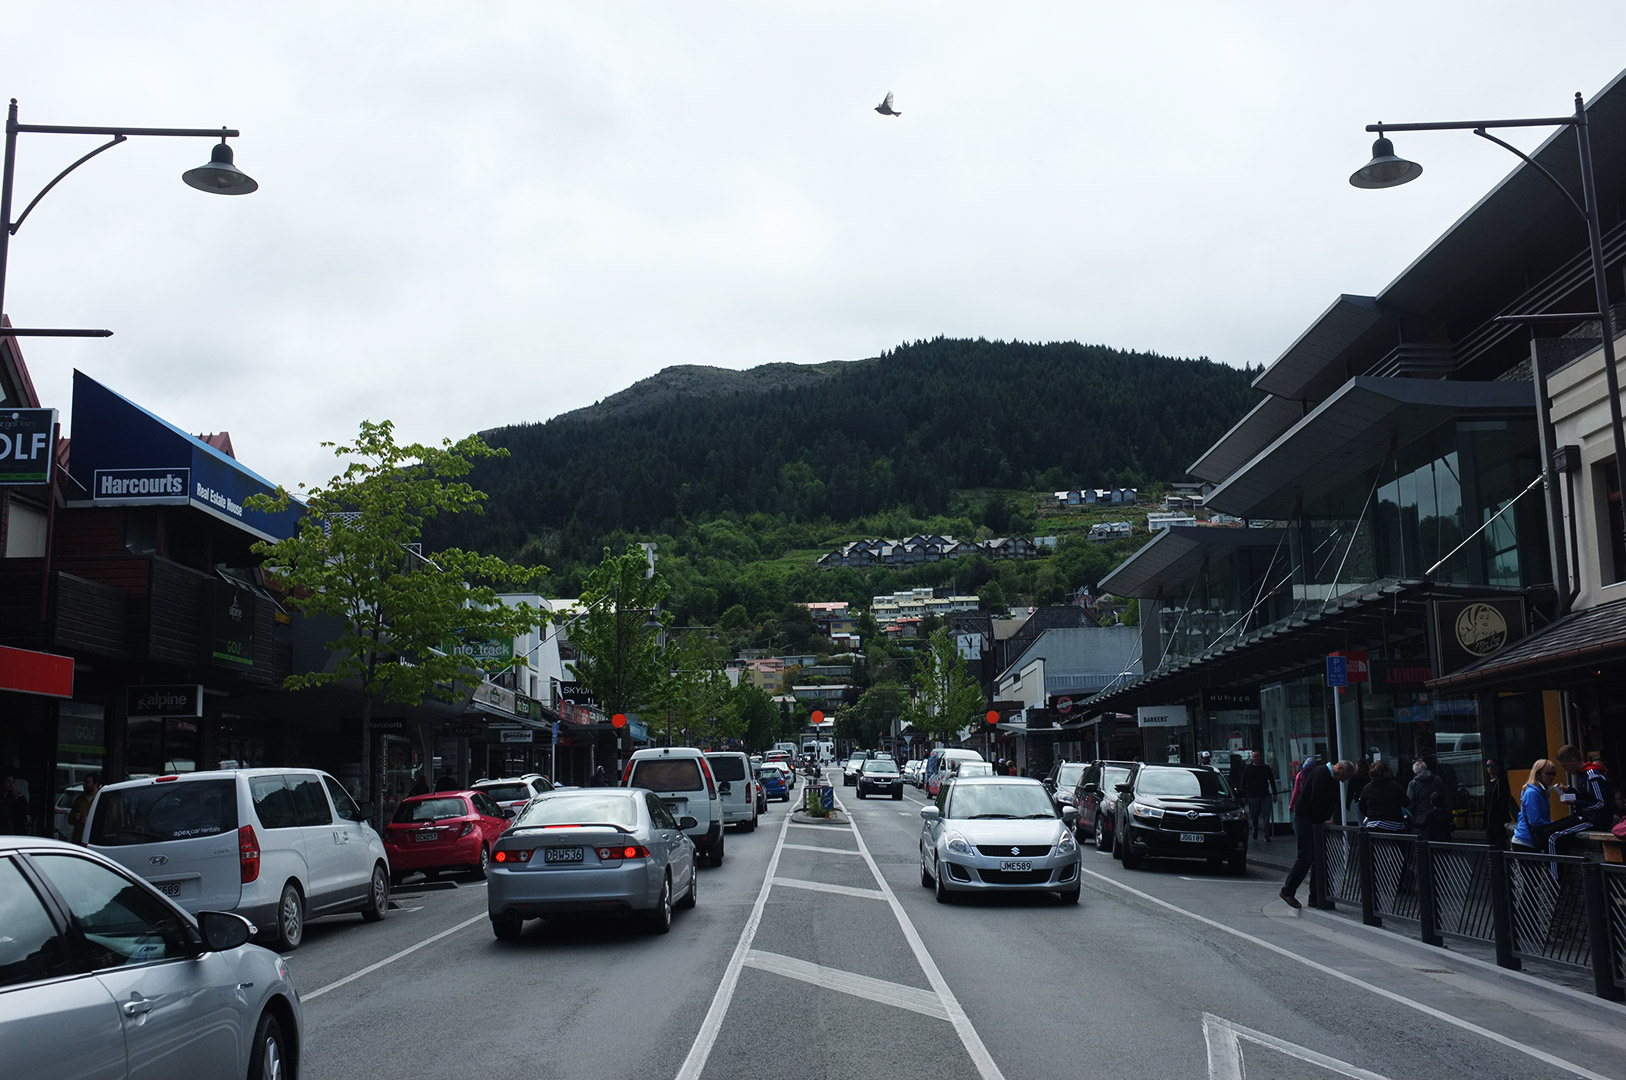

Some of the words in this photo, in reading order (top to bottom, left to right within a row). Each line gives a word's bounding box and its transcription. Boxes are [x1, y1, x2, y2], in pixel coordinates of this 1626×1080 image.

[101, 474, 183, 495] Harcourts
[197, 482, 210, 501] Real
[209, 489, 226, 509] Estate
[227, 497, 242, 517] House
[479, 643, 510, 656] track
[148, 692, 188, 709] alpine
[1210, 695, 1250, 703] HUFFER
[76, 724, 97, 740] GOLF
[546, 849, 582, 860] DBW536
[1001, 862, 1031, 870] JME589
[158, 885, 179, 895] 689
